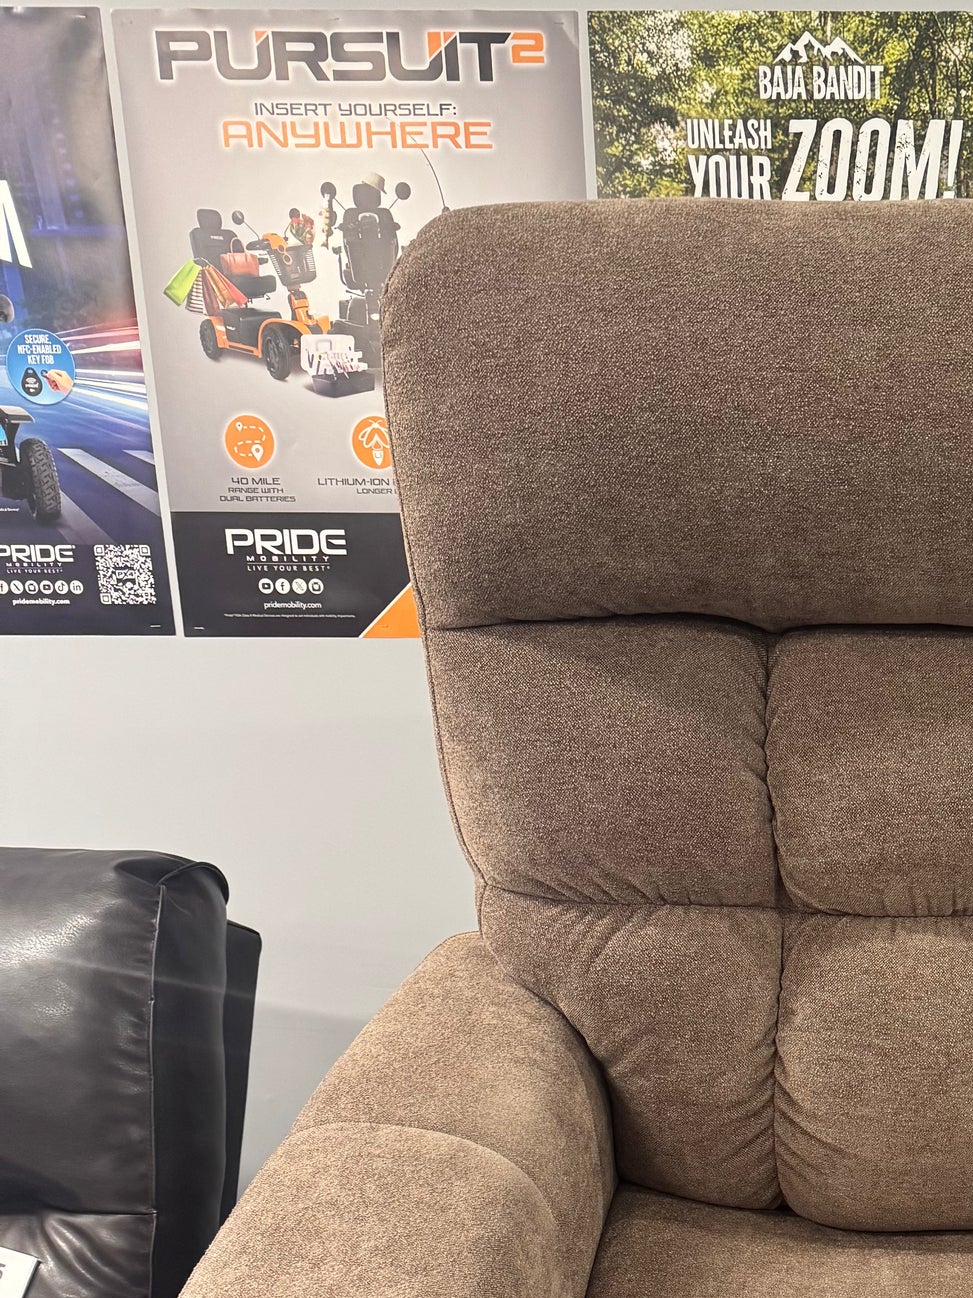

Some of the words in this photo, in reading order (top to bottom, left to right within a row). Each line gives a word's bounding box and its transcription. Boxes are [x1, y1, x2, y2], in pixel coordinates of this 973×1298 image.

[759, 65, 807, 100] BAJA
[812, 65, 884, 100] BANDIT
[254, 102, 332, 117] INSERT
[338, 102, 457, 117] YOURSELF:
[221, 120, 493, 149] ANYWHERE
[686, 118, 772, 149] UNLEASH
[687, 154, 772, 199] YOUR
[782, 117, 964, 201] ZOOM!
[24, 334, 52, 344] SECURE,
[17, 344, 62, 354] NFC-ENABLED
[27, 355, 40, 365] KEY
[41, 355, 54, 365] FOB
[231, 477, 249, 486] 40
[251, 477, 281, 486] MILE
[317, 477, 390, 486] LITHIUM-ION
[224, 528, 347, 555] PRIDE
[12, 598, 70, 606] pridemobility.com
[263, 601, 322, 610] pridemobility.com
